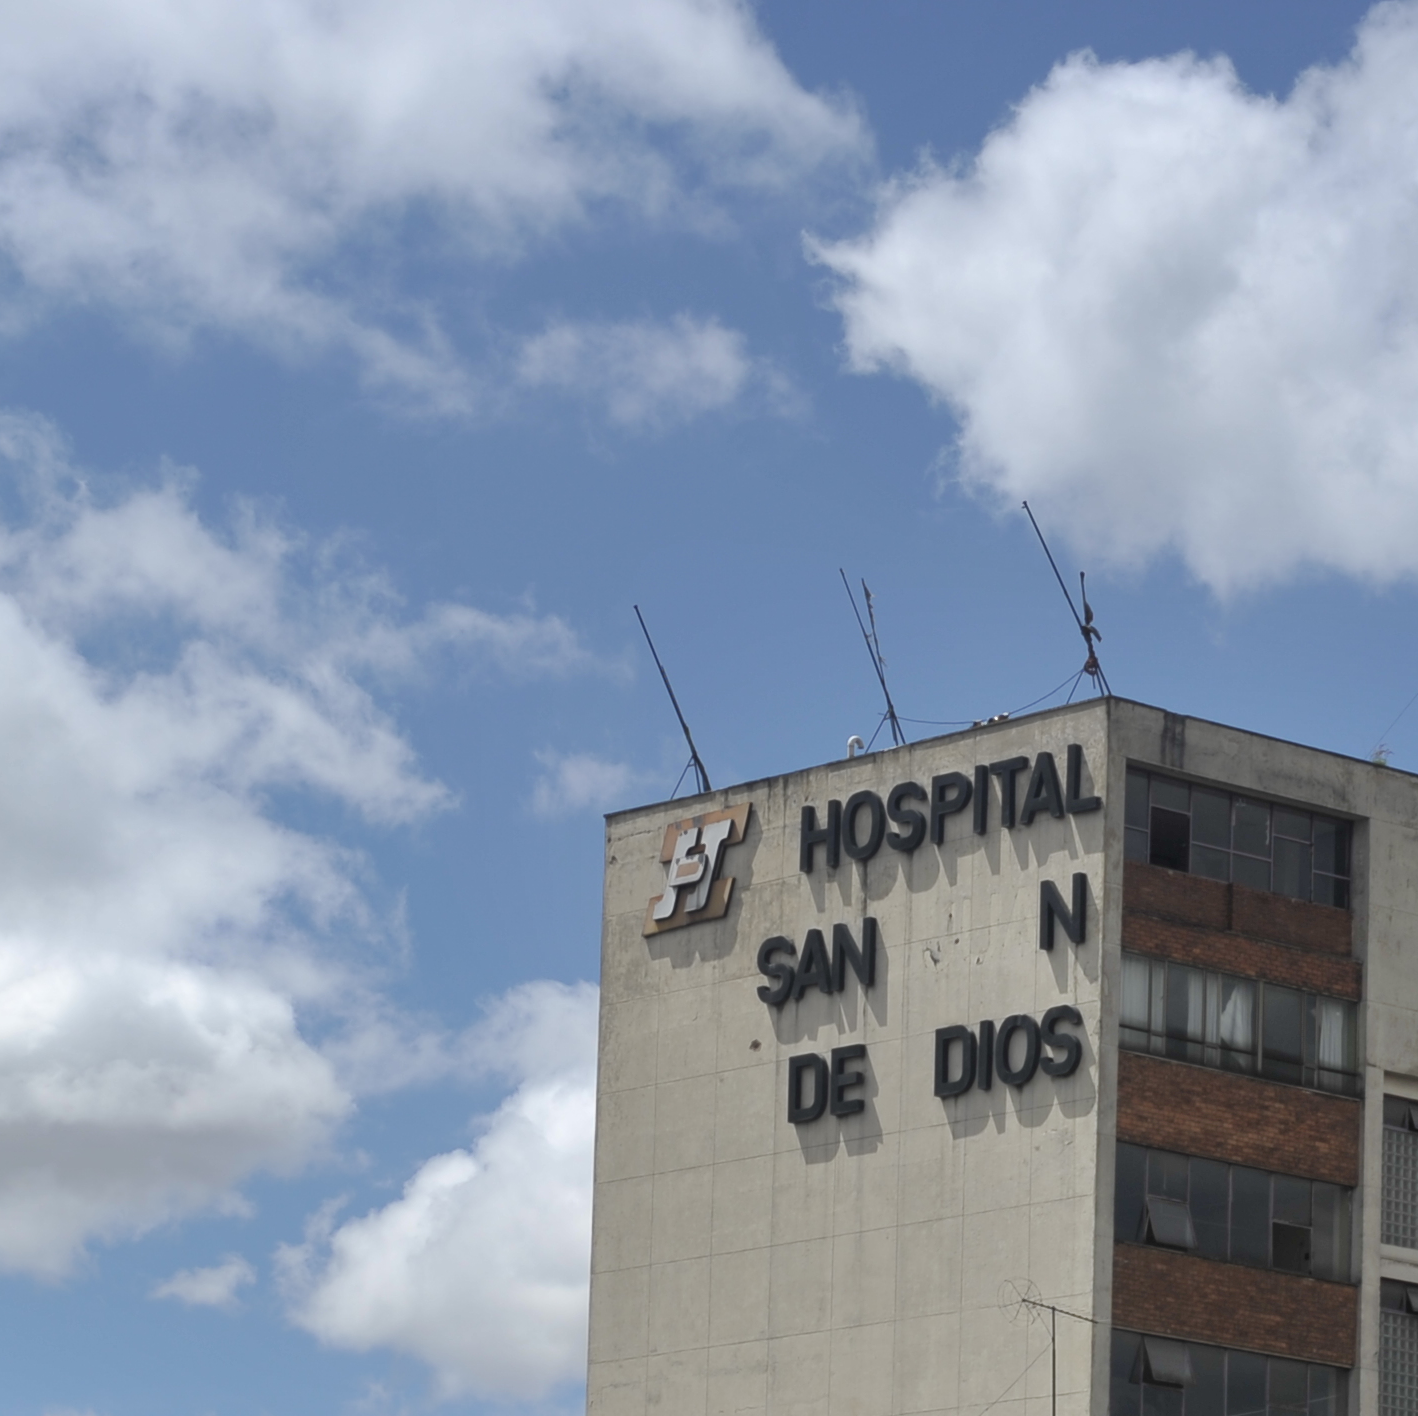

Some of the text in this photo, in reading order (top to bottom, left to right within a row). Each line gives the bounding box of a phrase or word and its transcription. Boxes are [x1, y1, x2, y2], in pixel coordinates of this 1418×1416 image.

[800, 744, 1102, 873] HOSPITAL
[756, 871, 1087, 1006] SAN N
[787, 1005, 1082, 1124] DE DIOS
